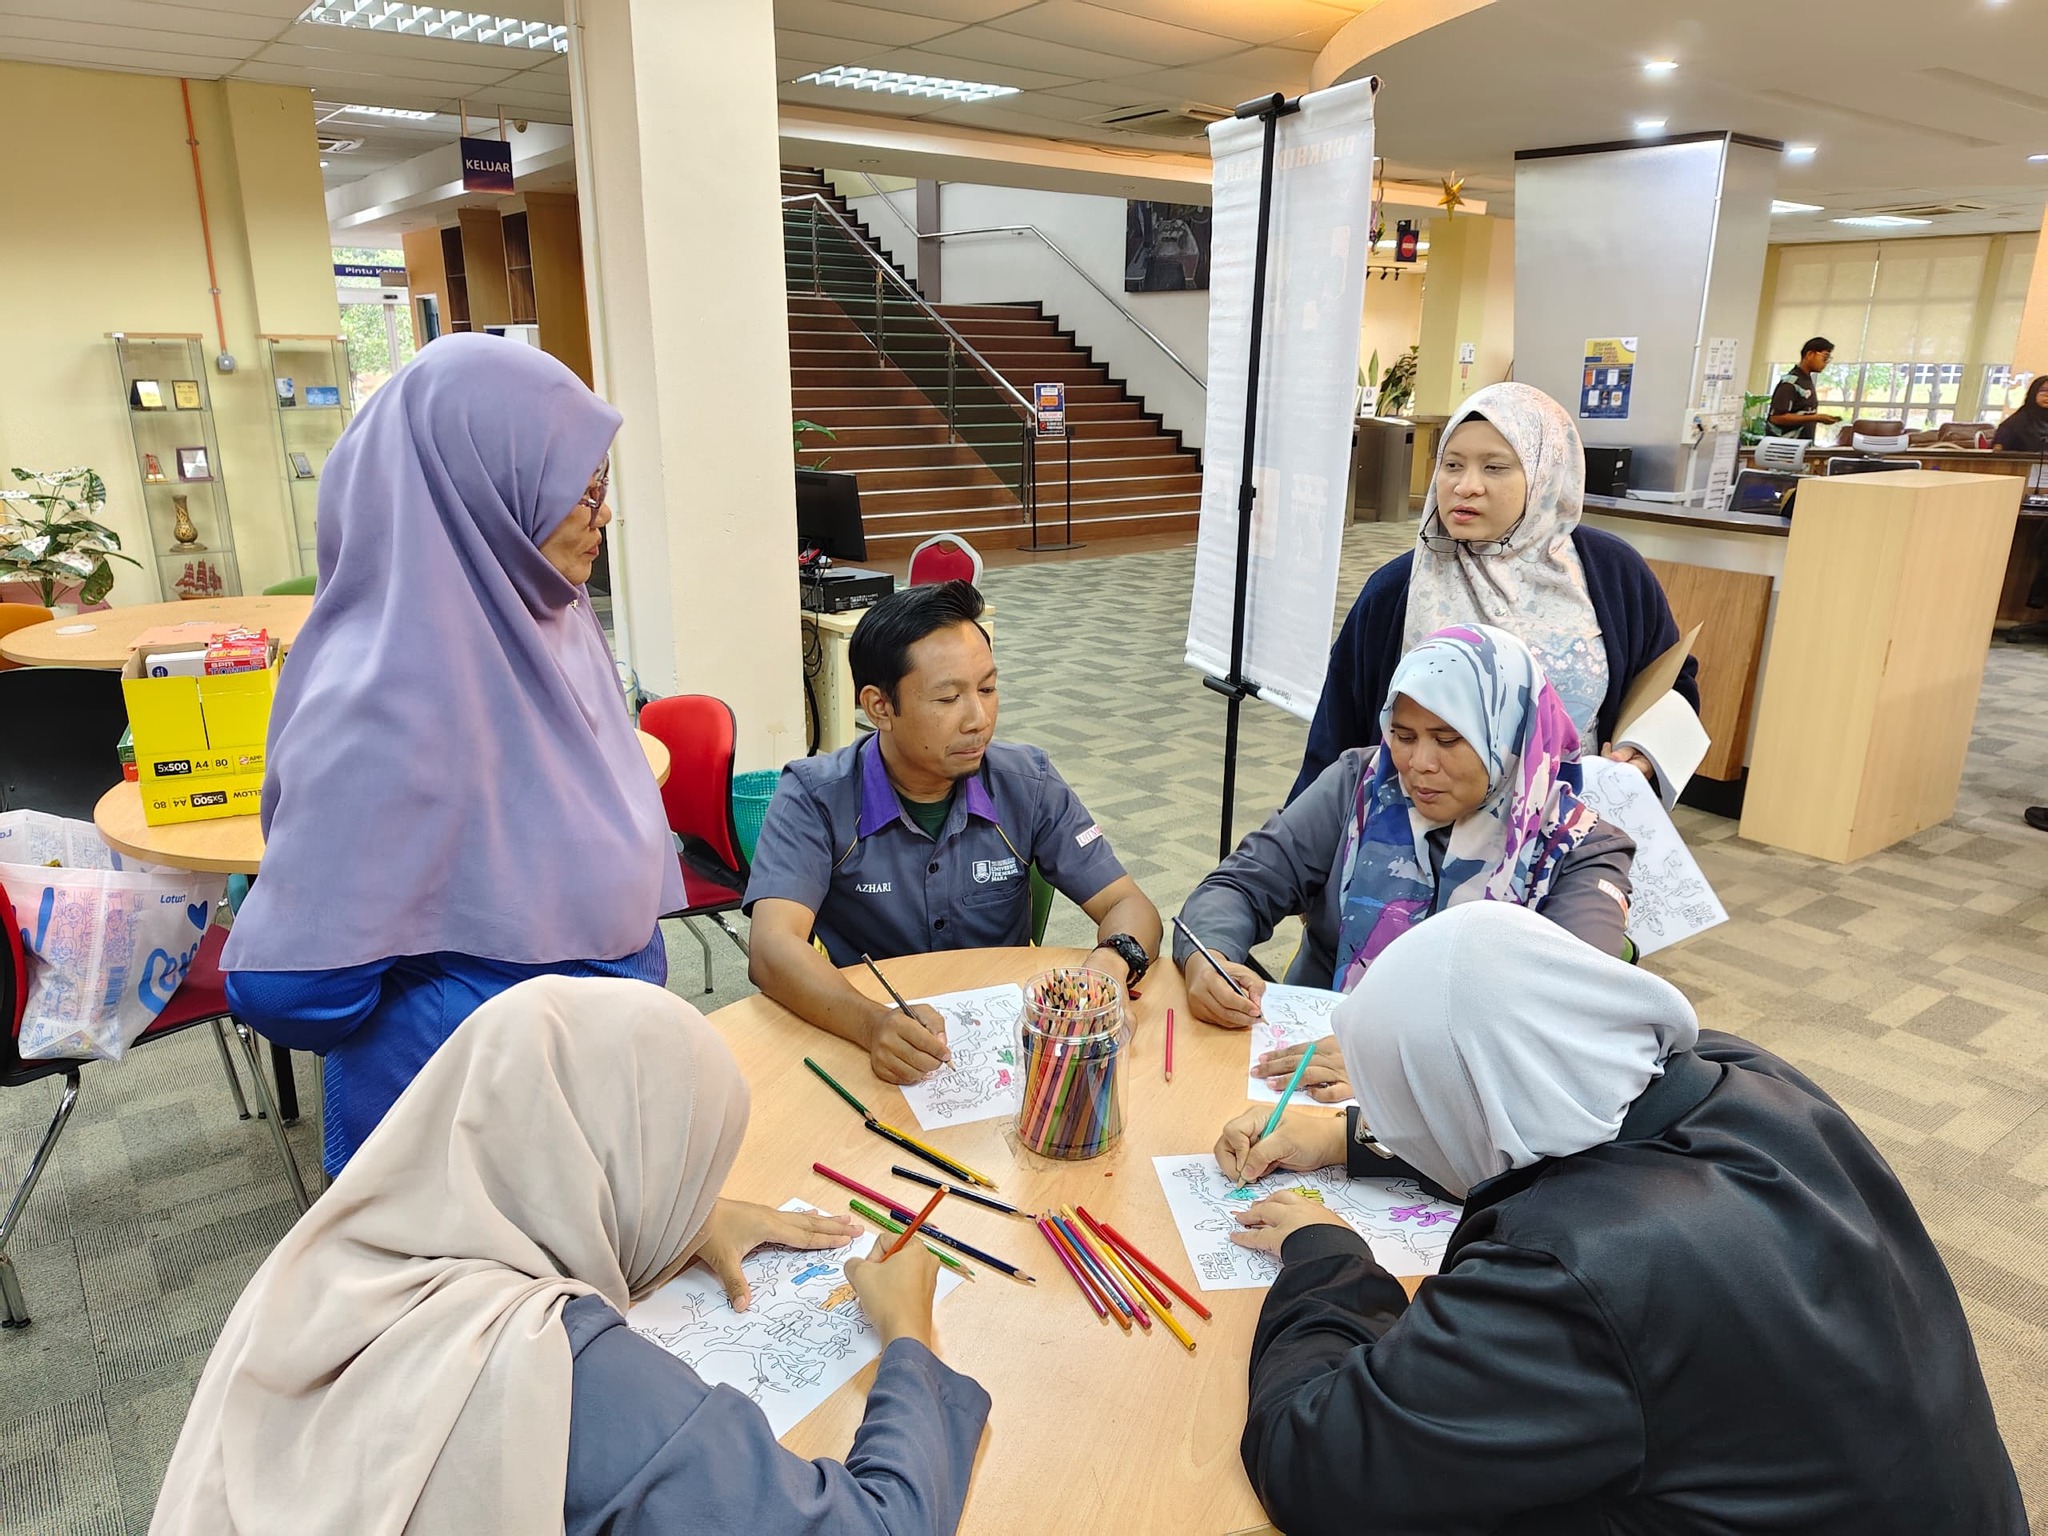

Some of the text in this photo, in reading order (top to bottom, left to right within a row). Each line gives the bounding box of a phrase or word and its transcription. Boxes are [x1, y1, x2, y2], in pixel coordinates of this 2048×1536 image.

[465, 159, 511, 173] KELUAR
[345, 266, 373, 275] Pintu
[157, 762, 188, 773] 5x500
[195, 760, 209, 769] A4
[215, 758, 228, 767] 80
[153, 789, 262, 809] ELLOW 5x500 A4 80
[855, 882, 891, 893] AZHARI
[1212, 1251, 1238, 1280] TREE
